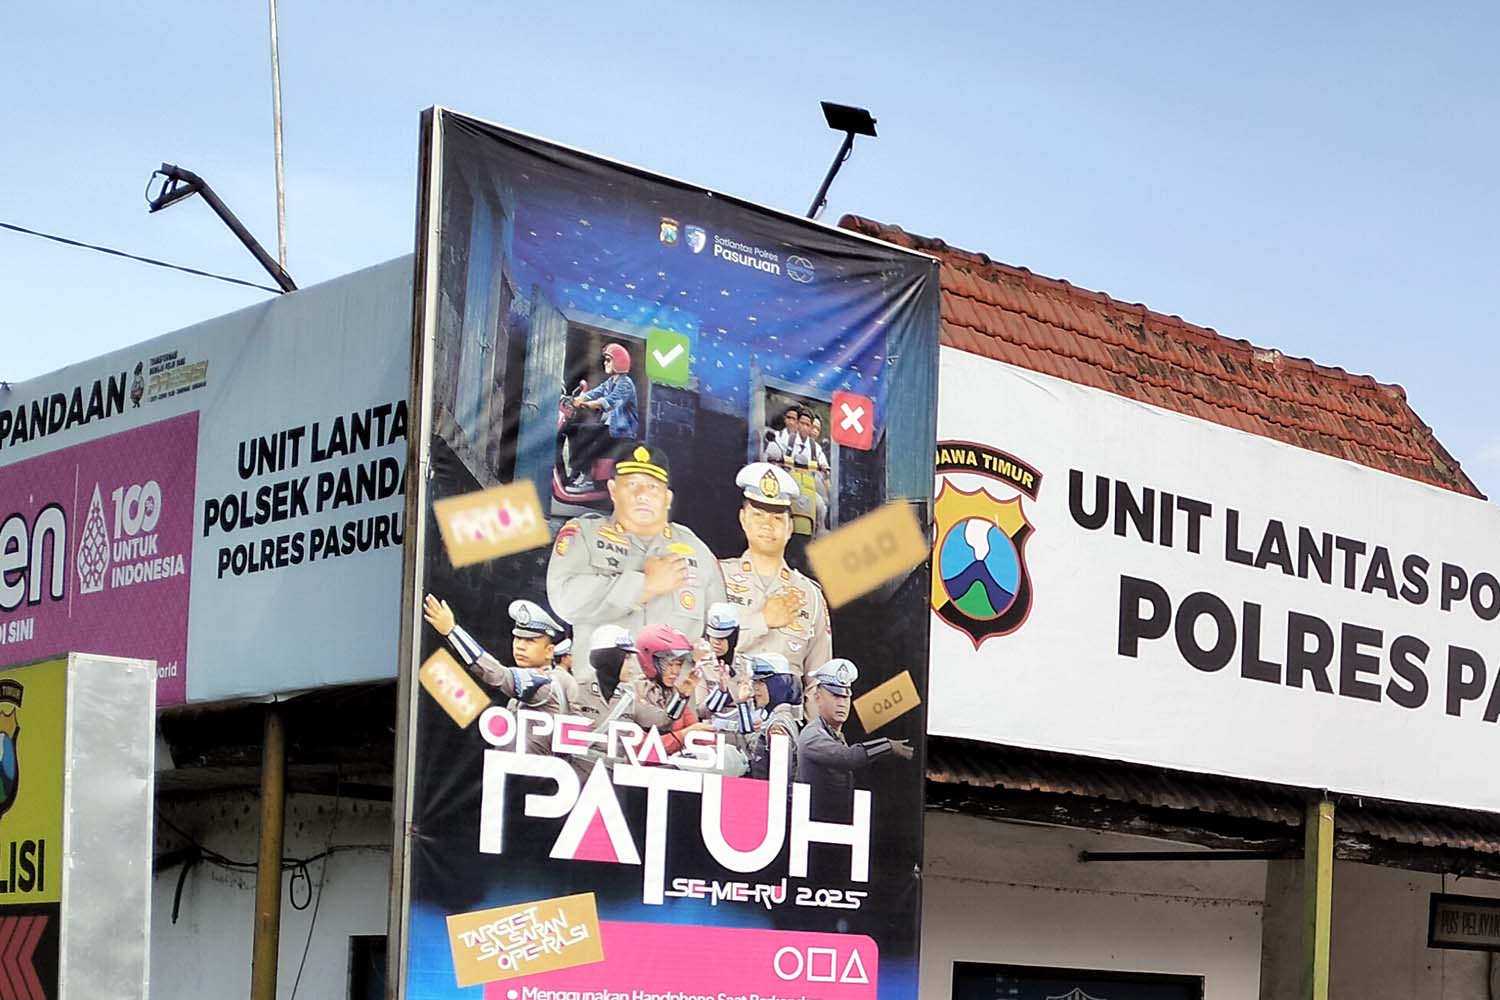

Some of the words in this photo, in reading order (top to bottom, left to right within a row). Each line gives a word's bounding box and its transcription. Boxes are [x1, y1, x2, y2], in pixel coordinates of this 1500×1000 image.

[713, 235, 753, 254] Satlantas
[713, 244, 781, 276] Pasuruan
[237, 425, 306, 480] UNIT
[981, 453, 1035, 489] TIMUR
[203, 476, 310, 538] POLSEK
[113, 533, 158, 562] UNTUK
[217, 531, 305, 580] POLRES
[1068, 468, 1212, 554] UNIT
[1225, 507, 1430, 606] LANTAS
[111, 553, 185, 589] INDONESIA
[8, 617, 34, 644] SINI
[1117, 574, 1431, 709] POLRES
[154, 661, 177, 681] orld
[478, 706, 726, 770] OPERASI
[479, 734, 872, 905] PATUH
[664, 874, 787, 911] SEMERU
[796, 886, 869, 910] 2025
[457, 906, 540, 949] TARGET
[497, 923, 591, 972] OPERASI
